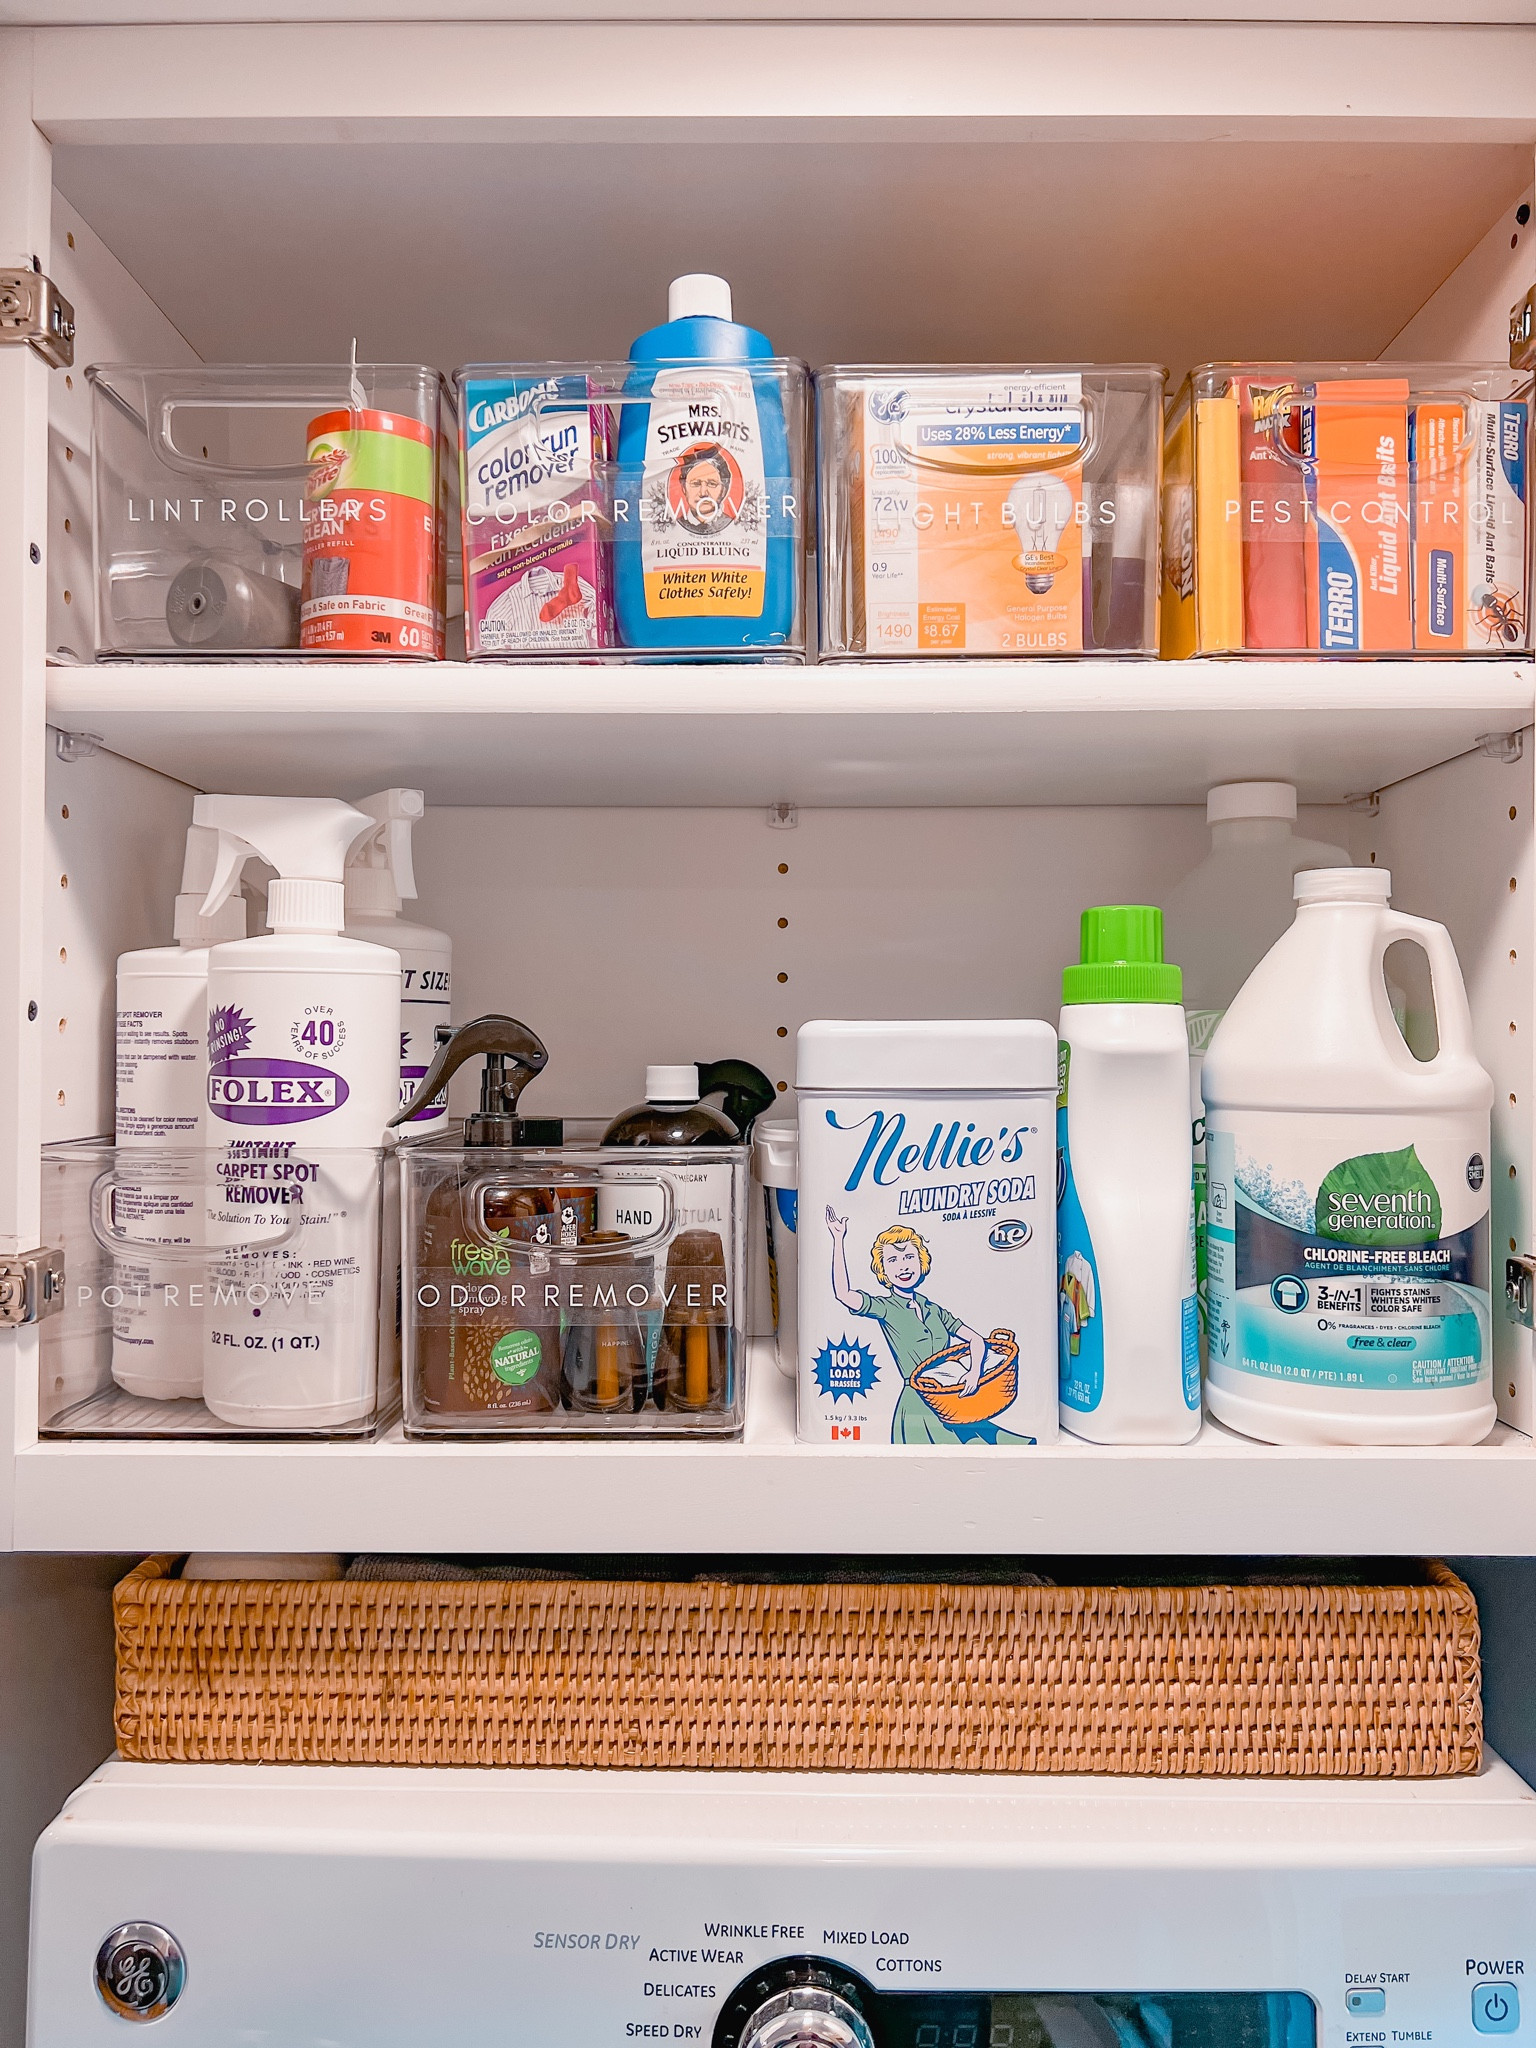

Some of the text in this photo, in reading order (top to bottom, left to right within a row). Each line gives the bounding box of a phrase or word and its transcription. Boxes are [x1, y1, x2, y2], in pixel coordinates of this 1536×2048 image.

[1003, 383, 1066, 393] energy-efficient
[688, 404, 722, 418] MRS.
[921, 427, 952, 442] Uses
[954, 426, 985, 440] 28%
[988, 425, 1017, 440] Less
[1503, 412, 1521, 462] TERRO
[478, 424, 579, 485] color run
[872, 497, 909, 512] 72W
[1484, 412, 1496, 584] Multi-Surface Ant Baits
[128, 498, 387, 522] LINT ROLLERS
[466, 499, 597, 525] COLOR
[613, 495, 799, 523] REMOVER
[1001, 501, 1118, 525] BULBS
[1225, 501, 1513, 524] PEST CONTROL
[304, 520, 344, 544] CLEAN
[327, 539, 355, 548] REFILL
[497, 539, 574, 580] safe non-bleach formula
[657, 547, 751, 559] LIQUID BLUING
[872, 562, 888, 573] 0.9
[1378, 529, 1402, 595] Liquid
[662, 572, 748, 586] Whiten White
[658, 586, 752, 602] Clothes Safely!
[1434, 558, 1448, 627] Multi-Surface
[319, 600, 336, 612] Safe
[338, 602, 350, 610] on
[352, 599, 387, 612] Fabric
[926, 605, 957, 613] Estimated
[1006, 604, 1068, 614] General Purpose
[1325, 571, 1354, 648] TERRO
[404, 606, 428, 623] Great
[922, 614, 944, 622] Energy
[1014, 612, 1068, 623] Halogen Bulbs
[371, 630, 391, 644] 3M
[398, 625, 420, 648] 60
[876, 624, 912, 638] 1490
[924, 624, 959, 638] $8.67
[1001, 633, 1068, 648] 2 BULBS
[304, 1005, 334, 1016] OVER
[172, 1030, 188, 1038] Spots
[210, 1026, 244, 1053] RINSING!
[290, 1020, 346, 1060] YEARS OF SUCCESS
[301, 1020, 334, 1046] 40
[211, 1078, 325, 1103] FOLEX
[825, 1109, 1031, 1192] Nellie's
[216, 1162, 320, 1183] CARPET SPOT
[225, 1184, 304, 1205] REMOVER
[898, 1175, 1037, 1216] LAUNDRY SODA
[1327, 1189, 1433, 1213] seventh
[217, 1211, 267, 1226] Solution To
[615, 1208, 653, 1226] HAND
[942, 1207, 997, 1223] SODA À LESSIVE
[1327, 1212, 1433, 1232] generation
[993, 1225, 1026, 1245] he
[451, 1238, 510, 1261] fresh
[1303, 1247, 1451, 1264] CHLORINE-FREE BLEACH
[287, 1257, 356, 1269] INK RED WINE
[451, 1259, 511, 1277] wave
[1304, 1261, 1450, 1272] AGENT DE BLANCHIMENT SANS CHLORE
[311, 1267, 361, 1279] COSMETICS
[77, 1285, 148, 1308] POT
[164, 1283, 357, 1308] REMOVE
[416, 1284, 728, 1308] ODOR REMOVER
[458, 1293, 508, 1306] removing
[1317, 1285, 1361, 1302] 3-IN-1
[1370, 1288, 1431, 1297] FIGHTS STAINS
[1370, 1295, 1441, 1305] WHITENS WHITES
[458, 1305, 487, 1317] spray
[1317, 1300, 1362, 1312] BENEFITS
[1370, 1304, 1423, 1313] COLOR SAFE
[1317, 1318, 1337, 1332] 0%
[1338, 1323, 1375, 1331] FRAGRANCES
[1423, 1323, 1442, 1331] BLEACH
[211, 1331, 320, 1352] 32 FL. OZ. (1 QT.)
[1352, 1337, 1413, 1350] free & clear
[494, 1346, 540, 1369] NATURAL
[829, 1349, 862, 1368] 100
[1411, 1359, 1442, 1371] CAUTION
[829, 1368, 862, 1379] LOADS
[1241, 1356, 1366, 1384] 64 FL OZ LIQ (2.0 QT PTE) 1.89 L
[829, 1378, 862, 1388] BRASSÉES
[834, 1414, 843, 1422] kg
[858, 1414, 869, 1422] lbs
[703, 1922, 806, 1939] WRINKLE FREE
[822, 1928, 911, 1946] MIXED LOAD
[533, 1930, 642, 1951] SENSOR DRY
[648, 1947, 745, 1965] ACTIVE WEAR
[875, 1956, 944, 1973] COTTONS
[1465, 1958, 1525, 1977] POWER
[1344, 1972, 1411, 1984] DELAY START
[642, 1981, 717, 1999] DELICATES
[625, 2021, 703, 2041] SPEED DRY
[1345, 2029, 1434, 2043] EXTEND TUMBLE
